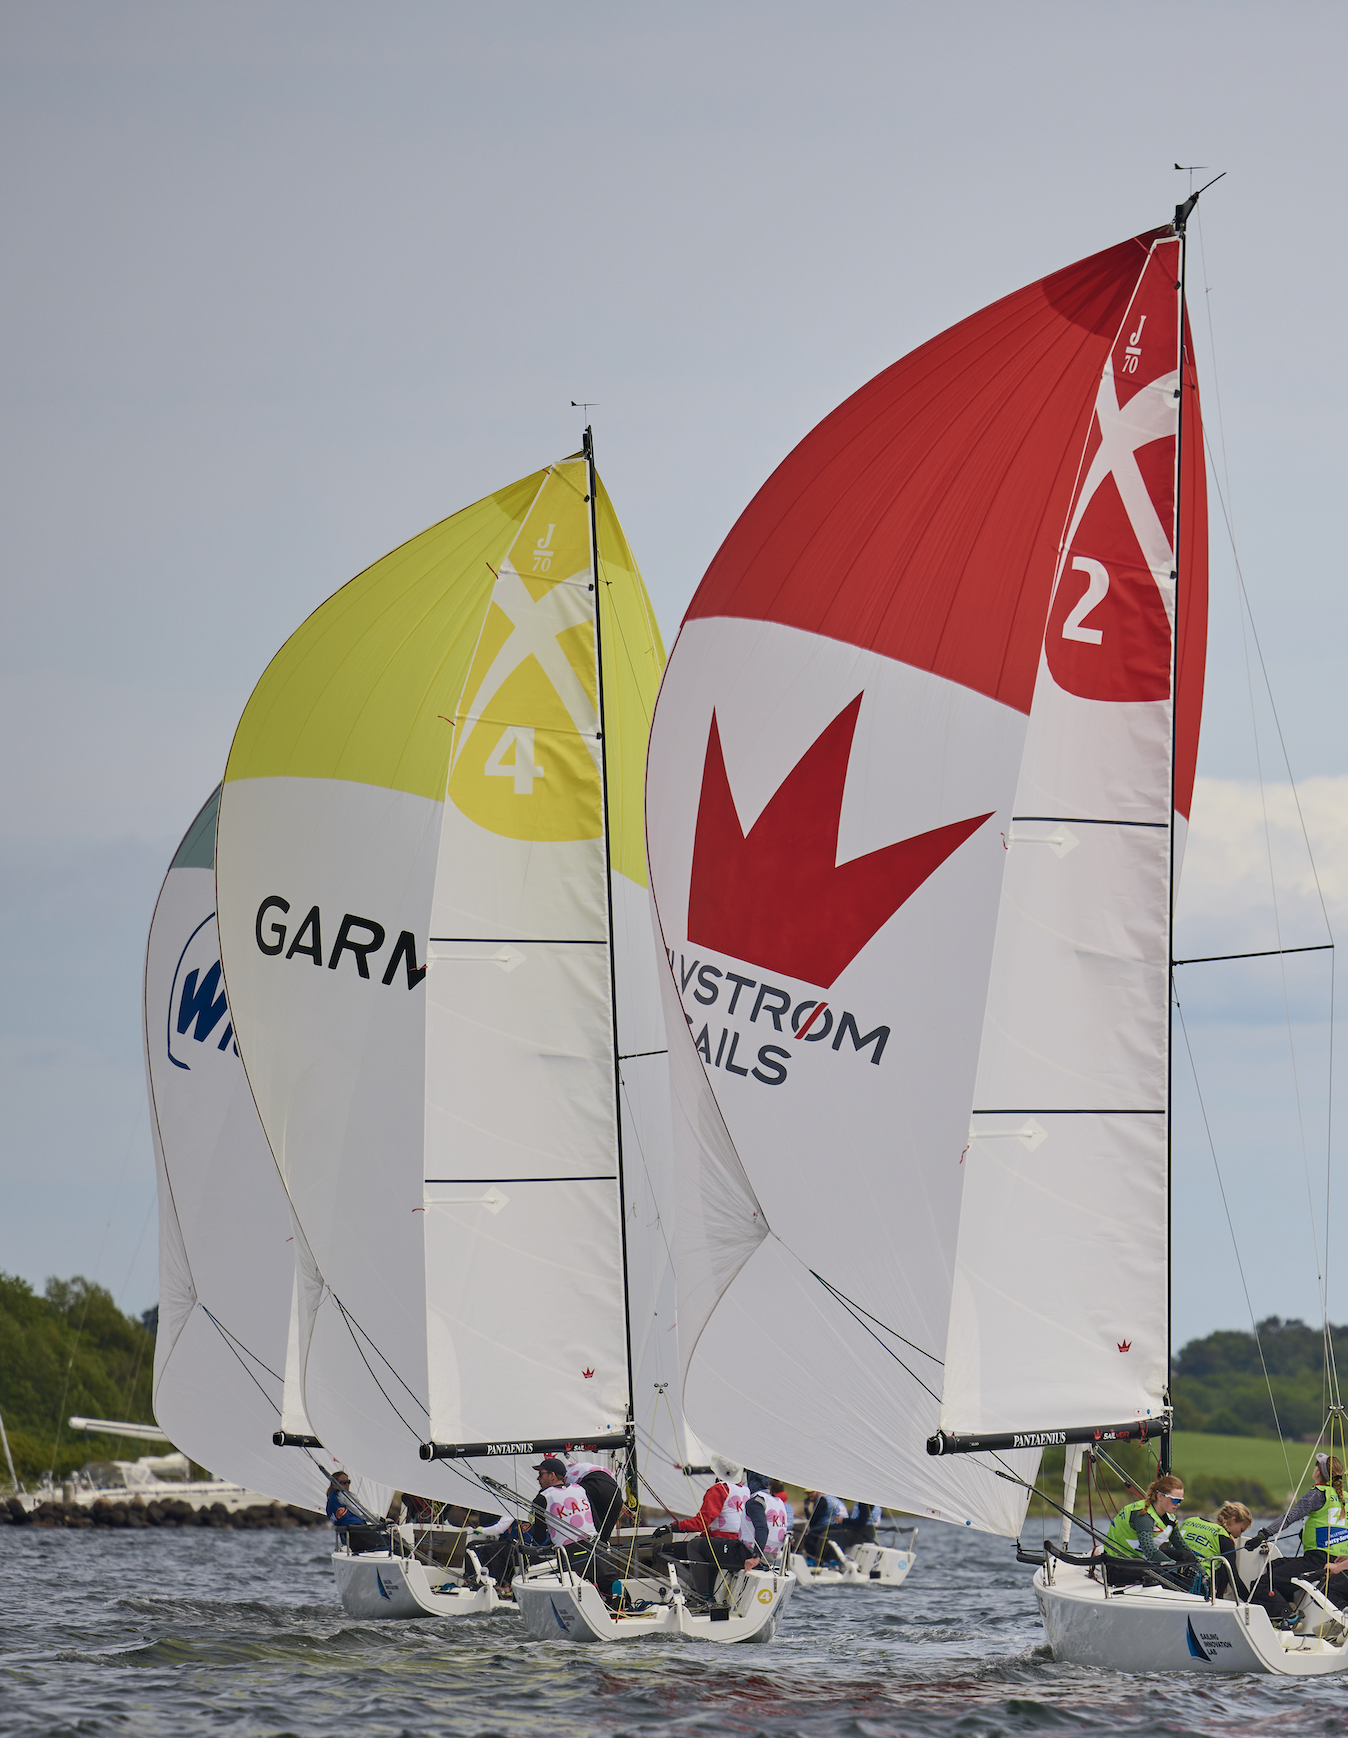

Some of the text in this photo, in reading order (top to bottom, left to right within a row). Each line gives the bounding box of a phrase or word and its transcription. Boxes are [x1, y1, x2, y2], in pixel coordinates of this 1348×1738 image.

[1122, 355, 1138, 374] 70
[1062, 556, 1109, 645] 2
[484, 726, 544, 795] 4
[685, 1013, 792, 1086] AILS
[487, 1443, 533, 1455] PANTAENIUS
[1013, 1432, 1067, 1447] PANTAENIUS
[758, 1591, 771, 1602] 4
